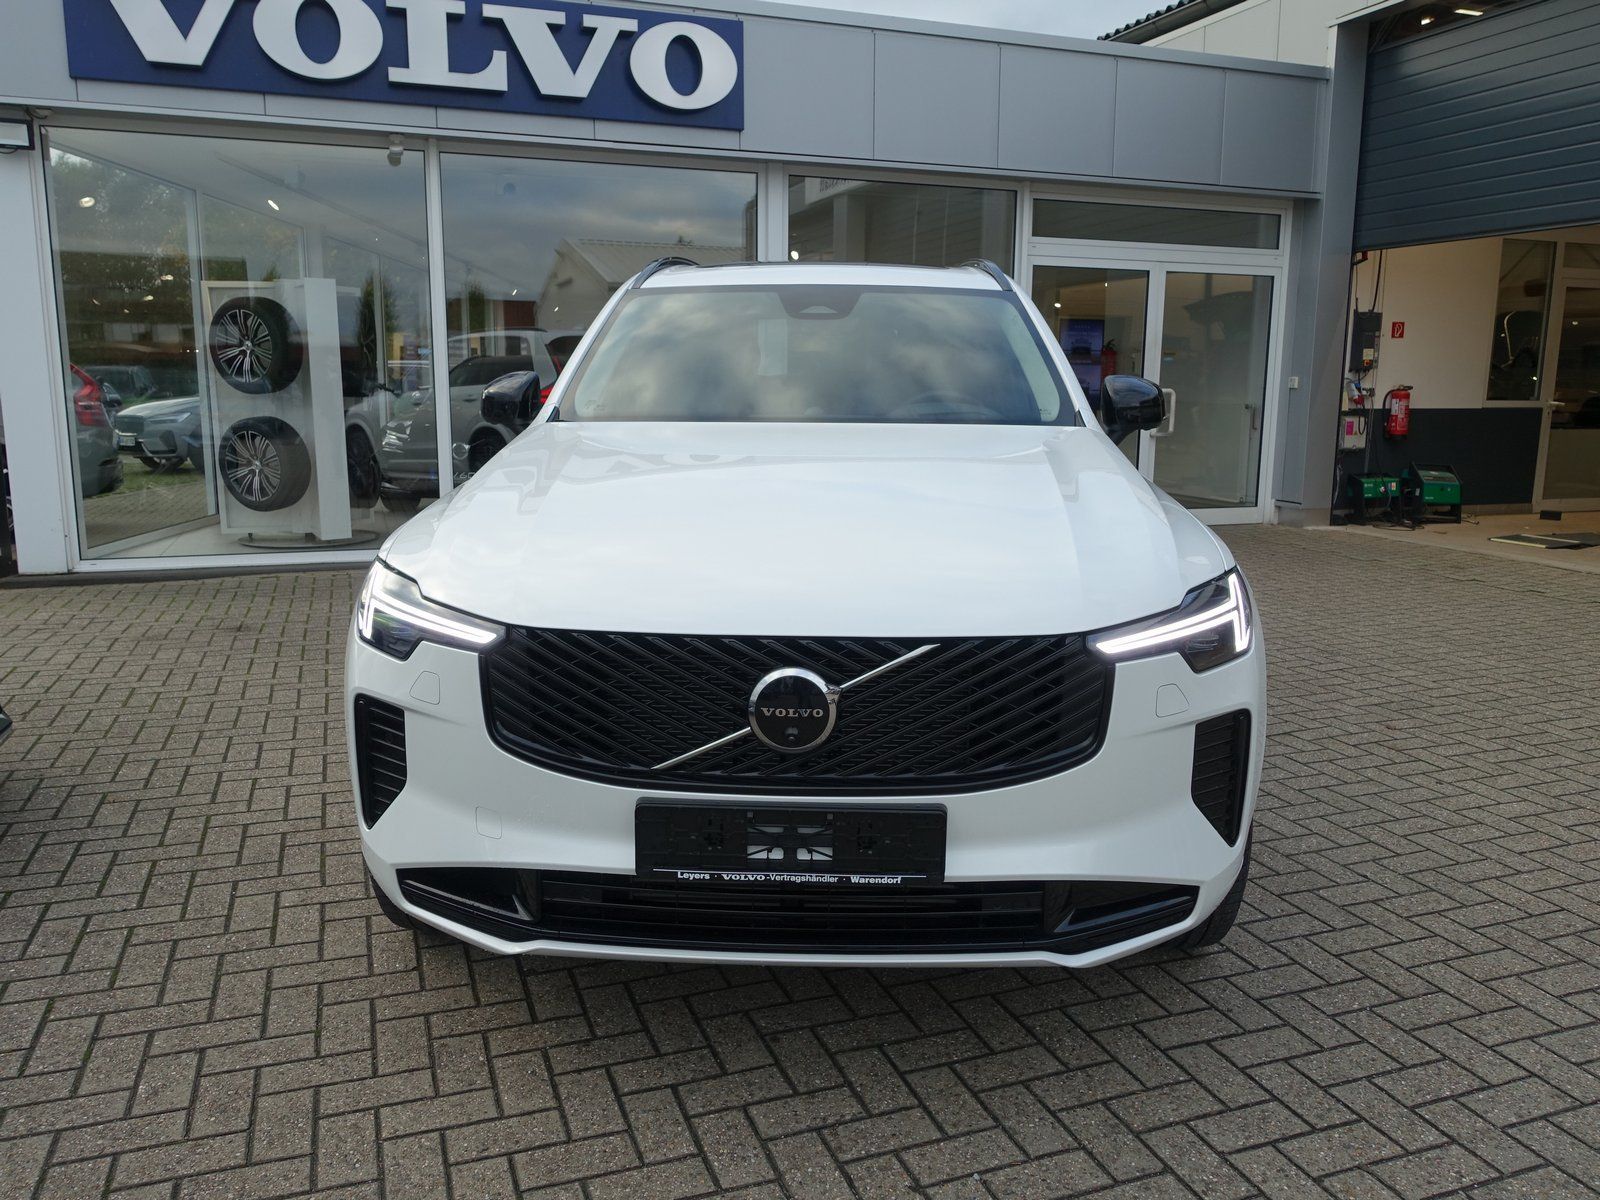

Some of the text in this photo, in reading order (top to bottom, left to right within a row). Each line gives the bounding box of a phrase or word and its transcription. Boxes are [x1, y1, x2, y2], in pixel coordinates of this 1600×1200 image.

[112, 0, 738, 110] VOLVO
[761, 707, 824, 718] VOLVO
[677, 871, 711, 880] Leyers
[850, 875, 901, 884] Warendorf
